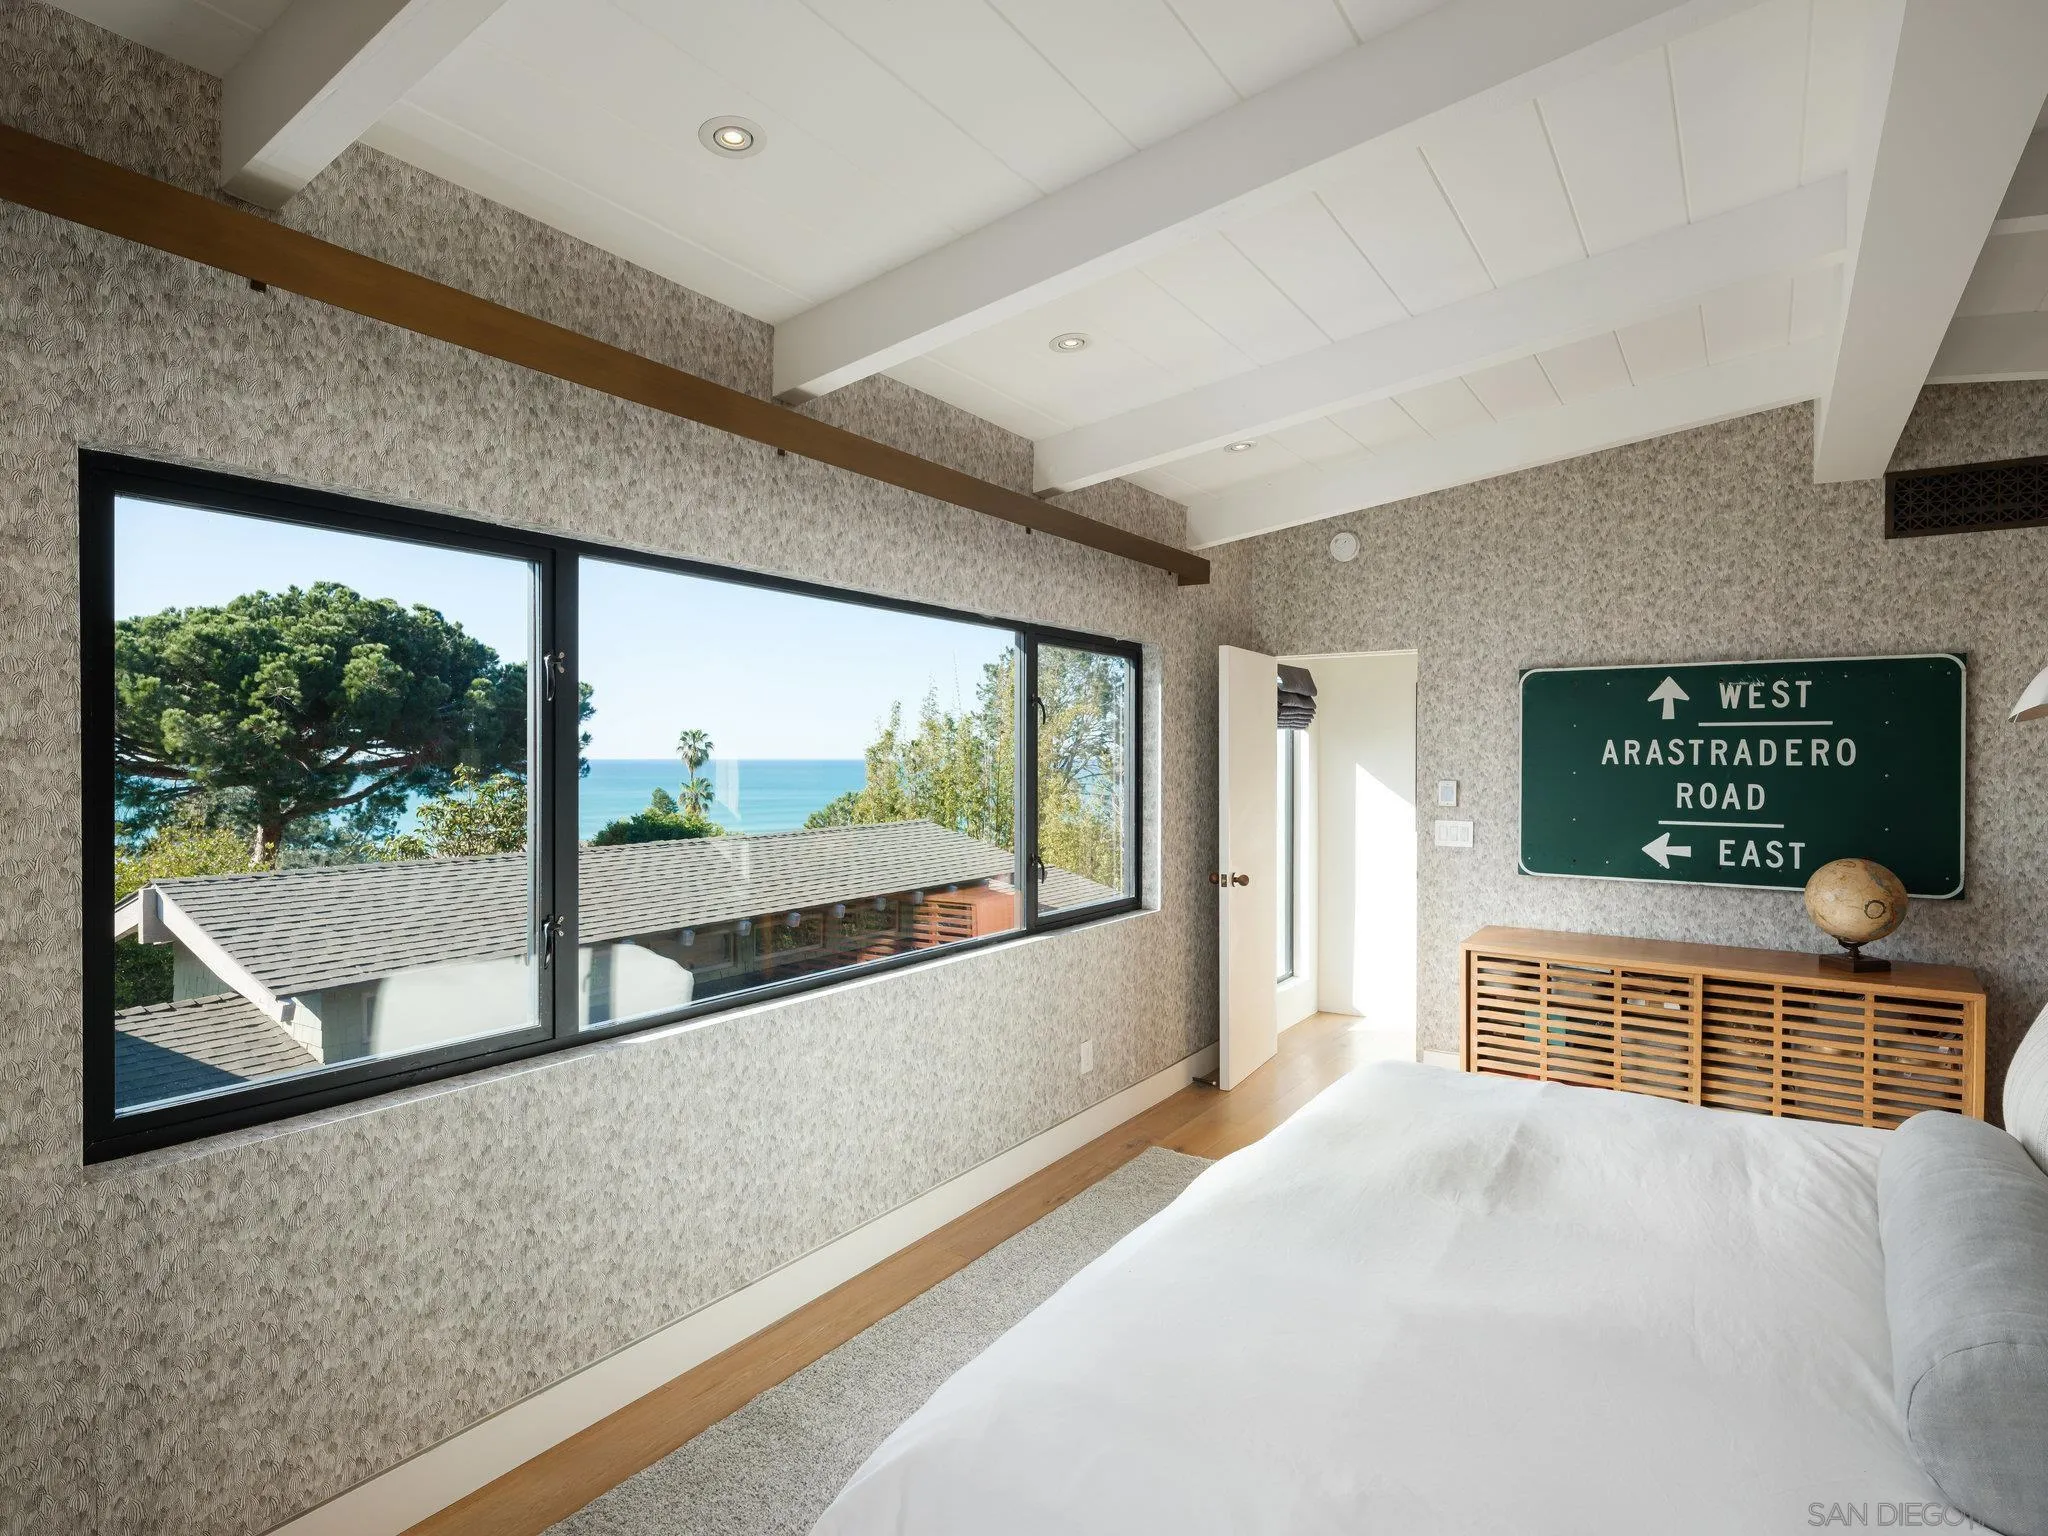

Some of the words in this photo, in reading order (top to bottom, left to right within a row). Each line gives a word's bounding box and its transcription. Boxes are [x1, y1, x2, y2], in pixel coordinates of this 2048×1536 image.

[1720, 680, 1812, 709] WEST
[1601, 738, 1857, 767] ARASTRADERO
[1676, 782, 1766, 811] ROAD
[1719, 839, 1806, 870] EAST
